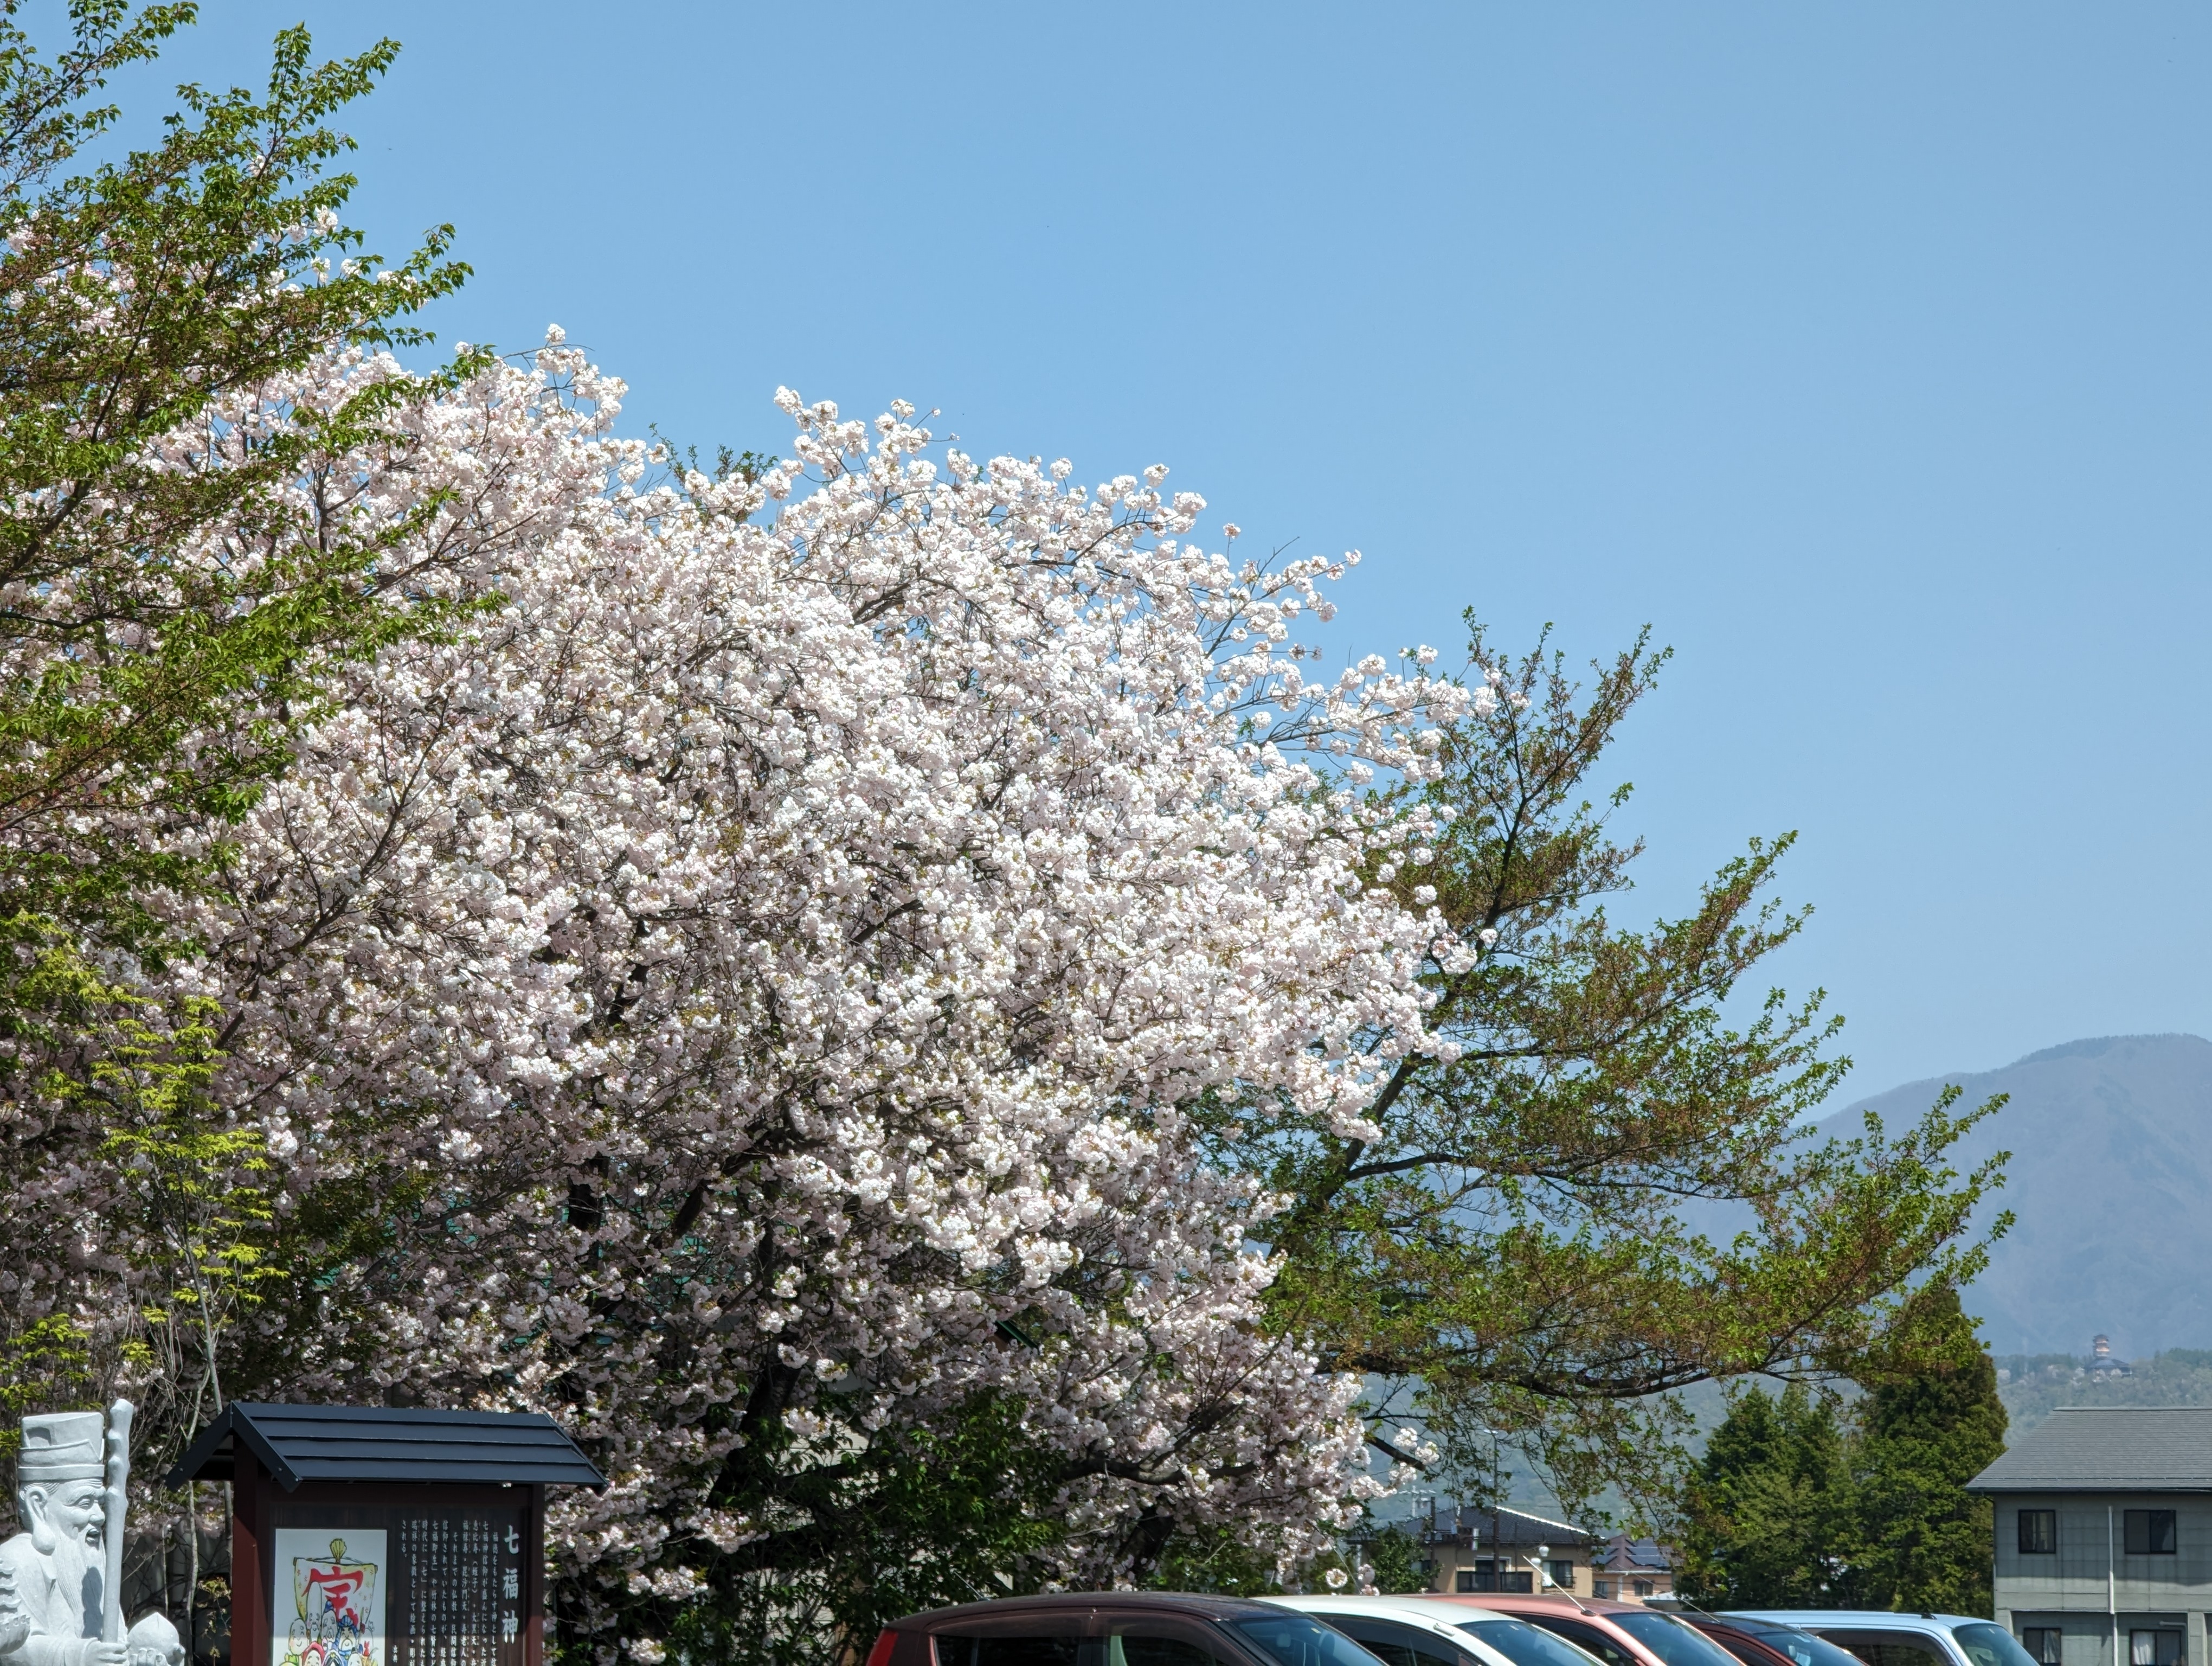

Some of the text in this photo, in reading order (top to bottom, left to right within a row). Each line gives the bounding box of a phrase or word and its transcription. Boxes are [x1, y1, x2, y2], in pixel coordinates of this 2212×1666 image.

[301, 1565, 364, 1629] 宝
[502, 1524, 520, 1644] 七福神
